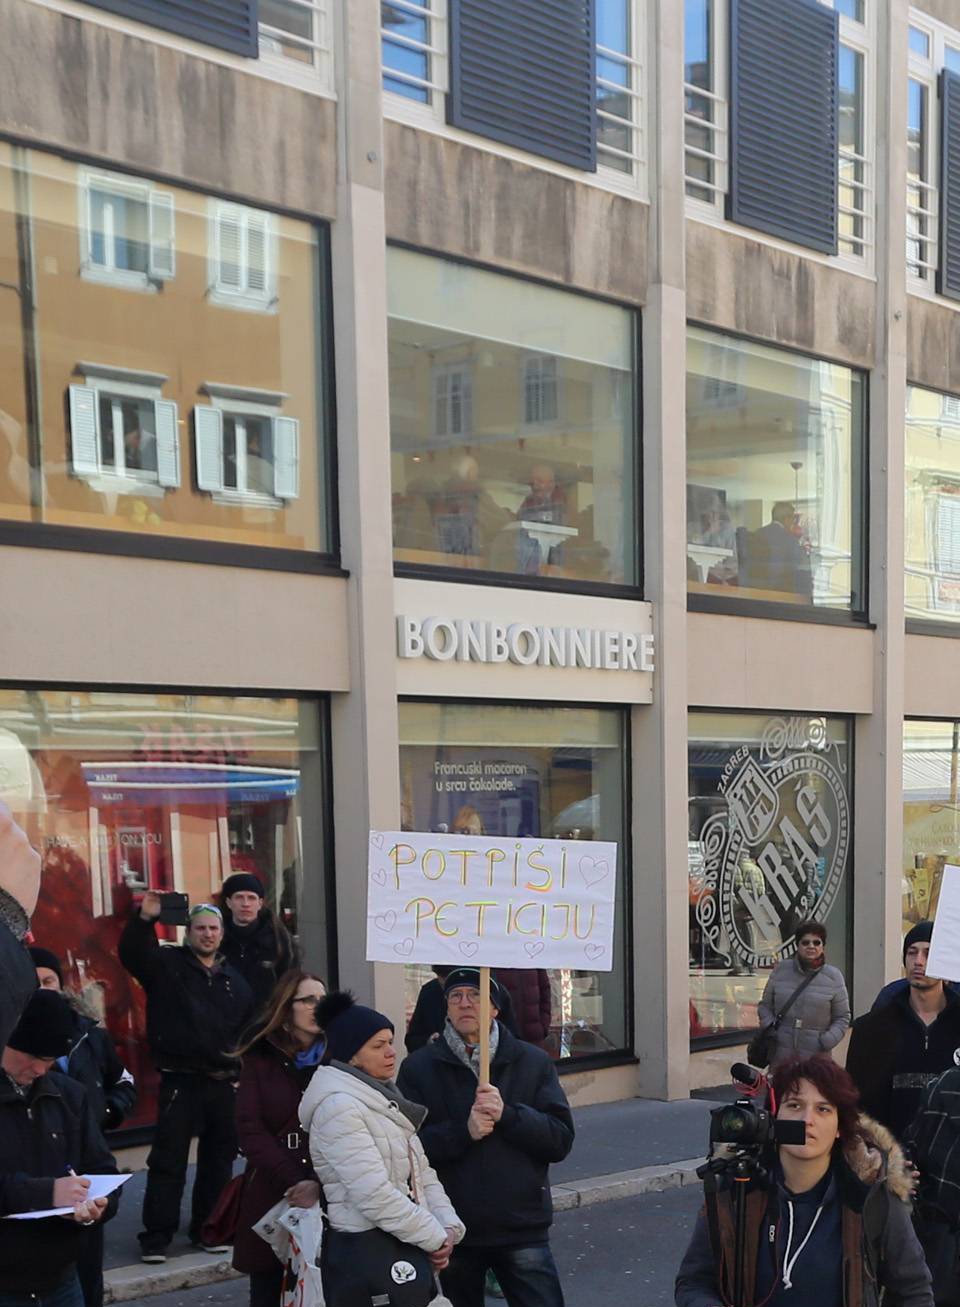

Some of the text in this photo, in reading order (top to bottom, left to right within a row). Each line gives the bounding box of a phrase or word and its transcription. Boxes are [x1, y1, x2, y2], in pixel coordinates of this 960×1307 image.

[396, 614, 656, 672] BONBONNIERE
[434, 761, 482, 775] Francuski
[717, 744, 750, 794] ZAGREB
[435, 781, 443, 791] u
[445, 781, 467, 791] srcu
